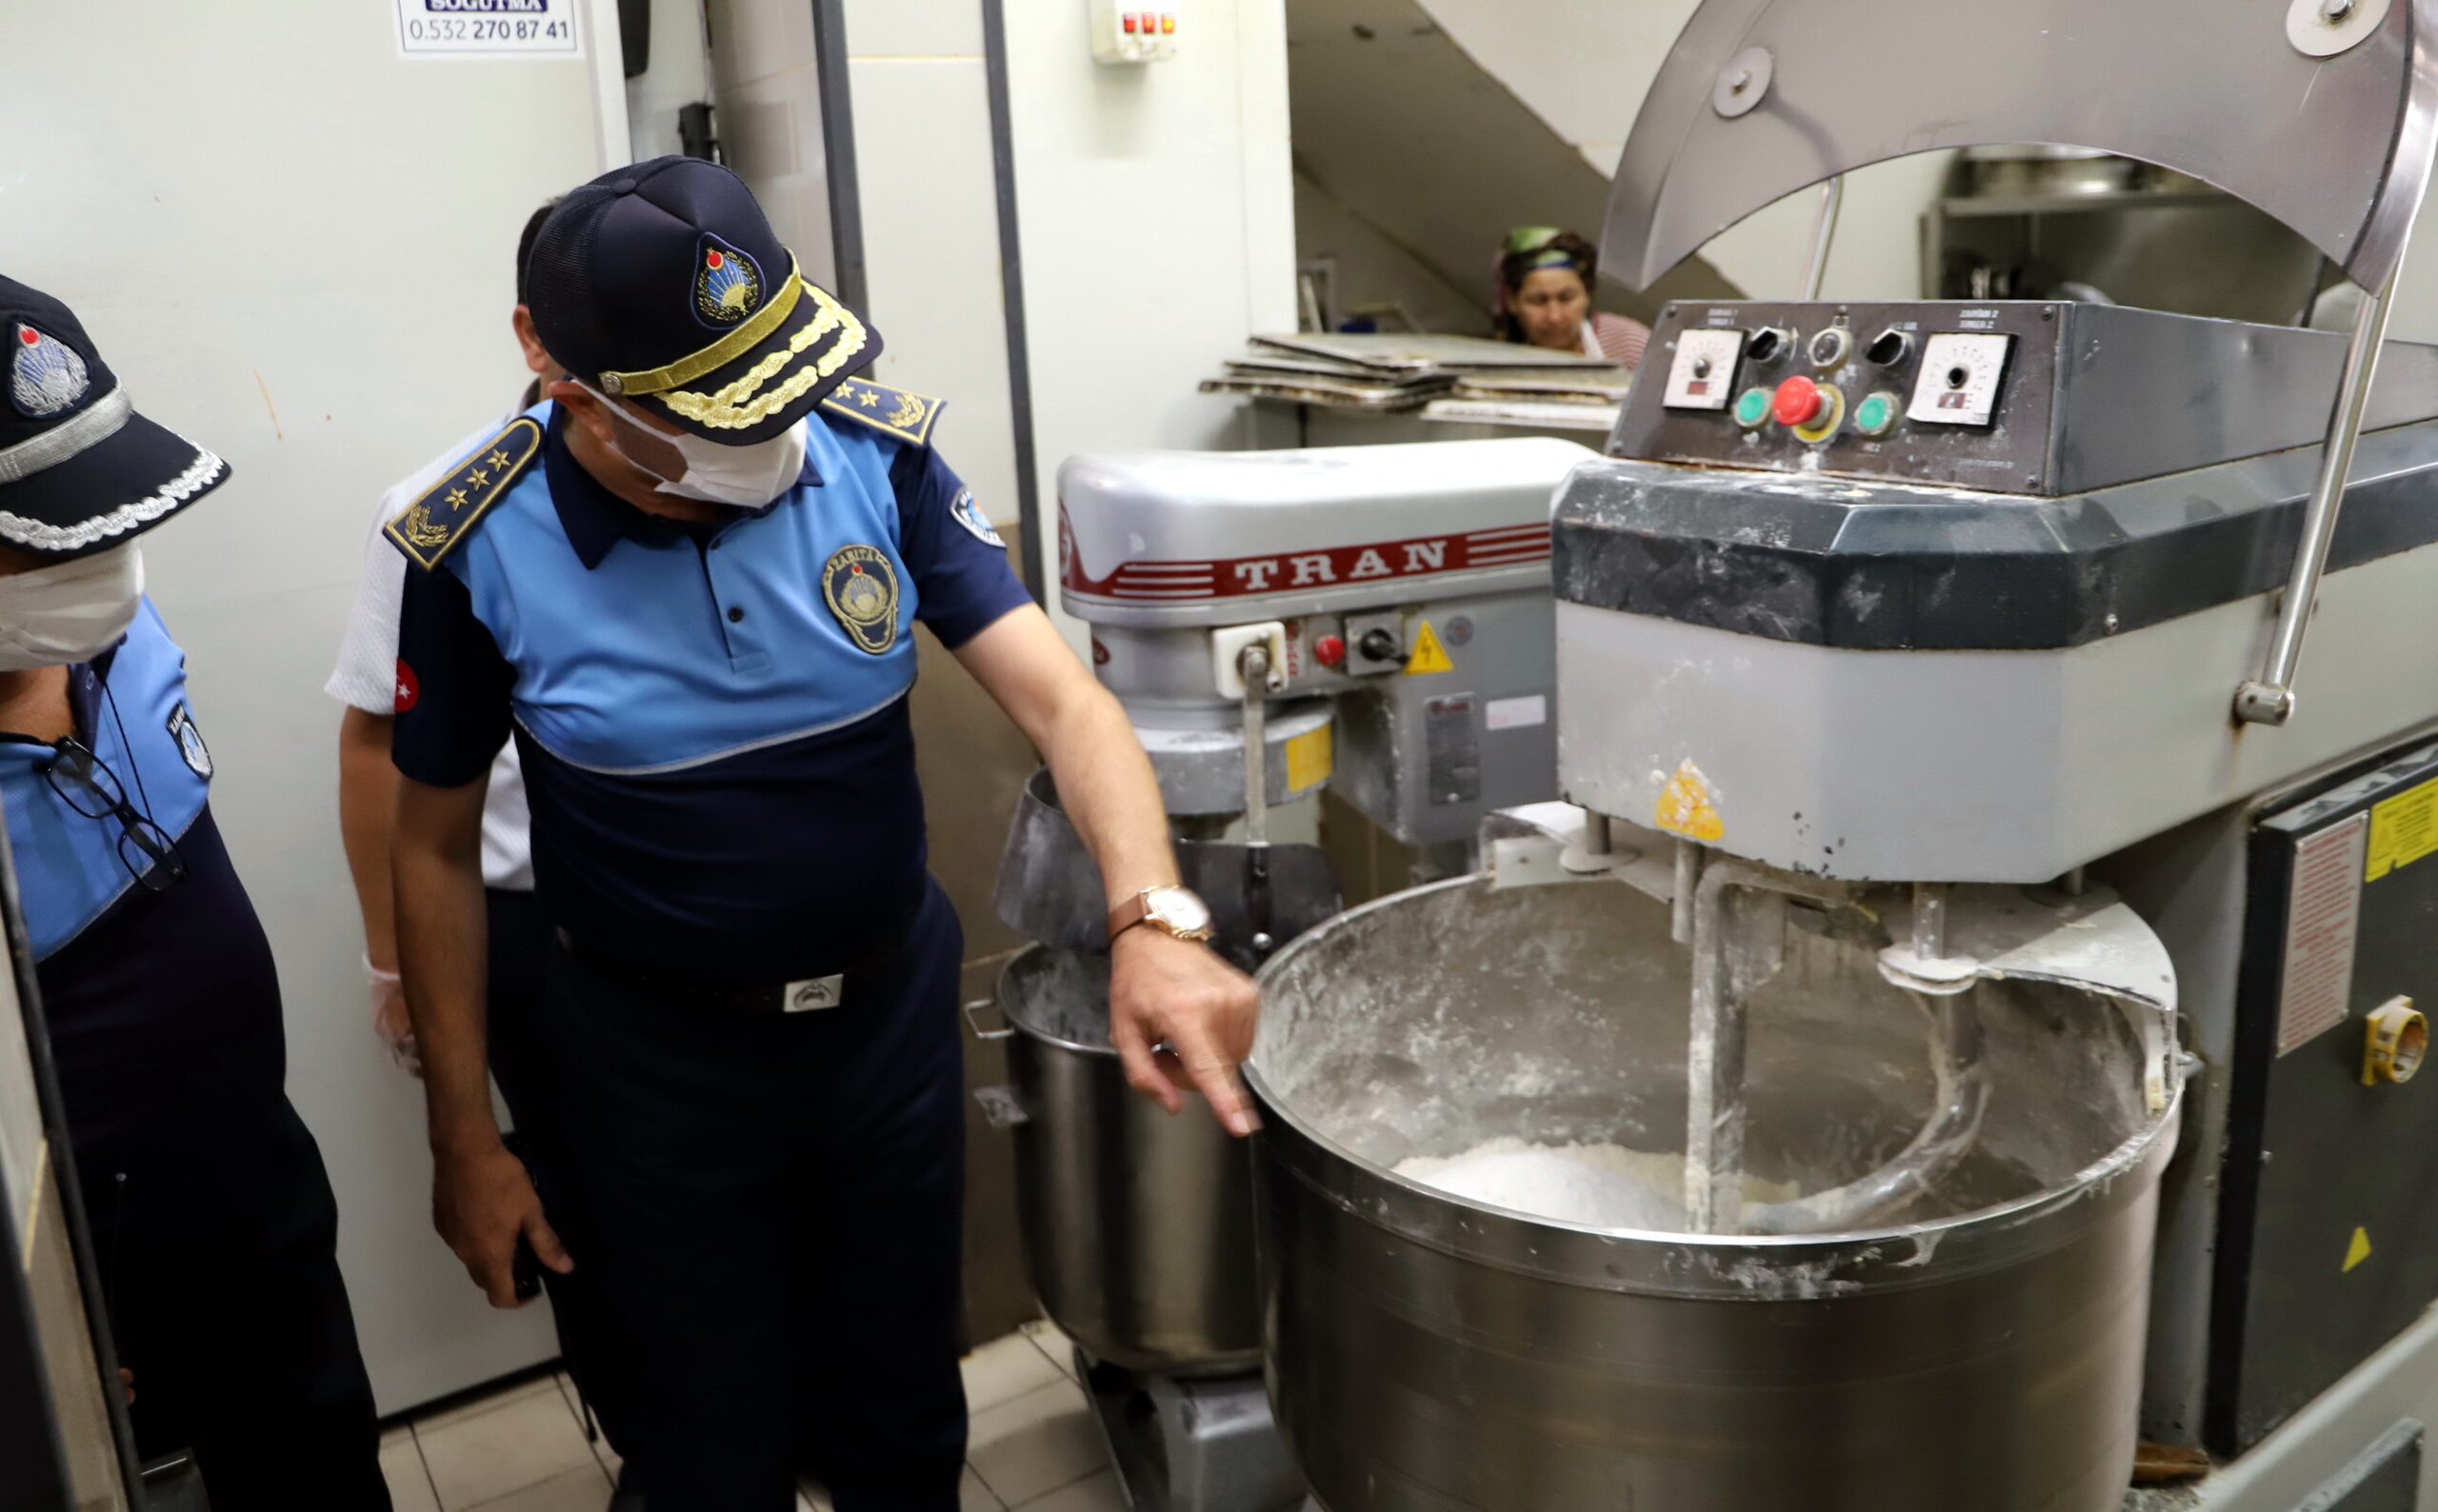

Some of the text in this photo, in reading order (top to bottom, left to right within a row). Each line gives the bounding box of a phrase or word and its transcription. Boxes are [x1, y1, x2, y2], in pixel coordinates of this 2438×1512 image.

[410, 19, 569, 40] 0.532 270 87 41
[1234, 540, 1448, 590] TRAN
